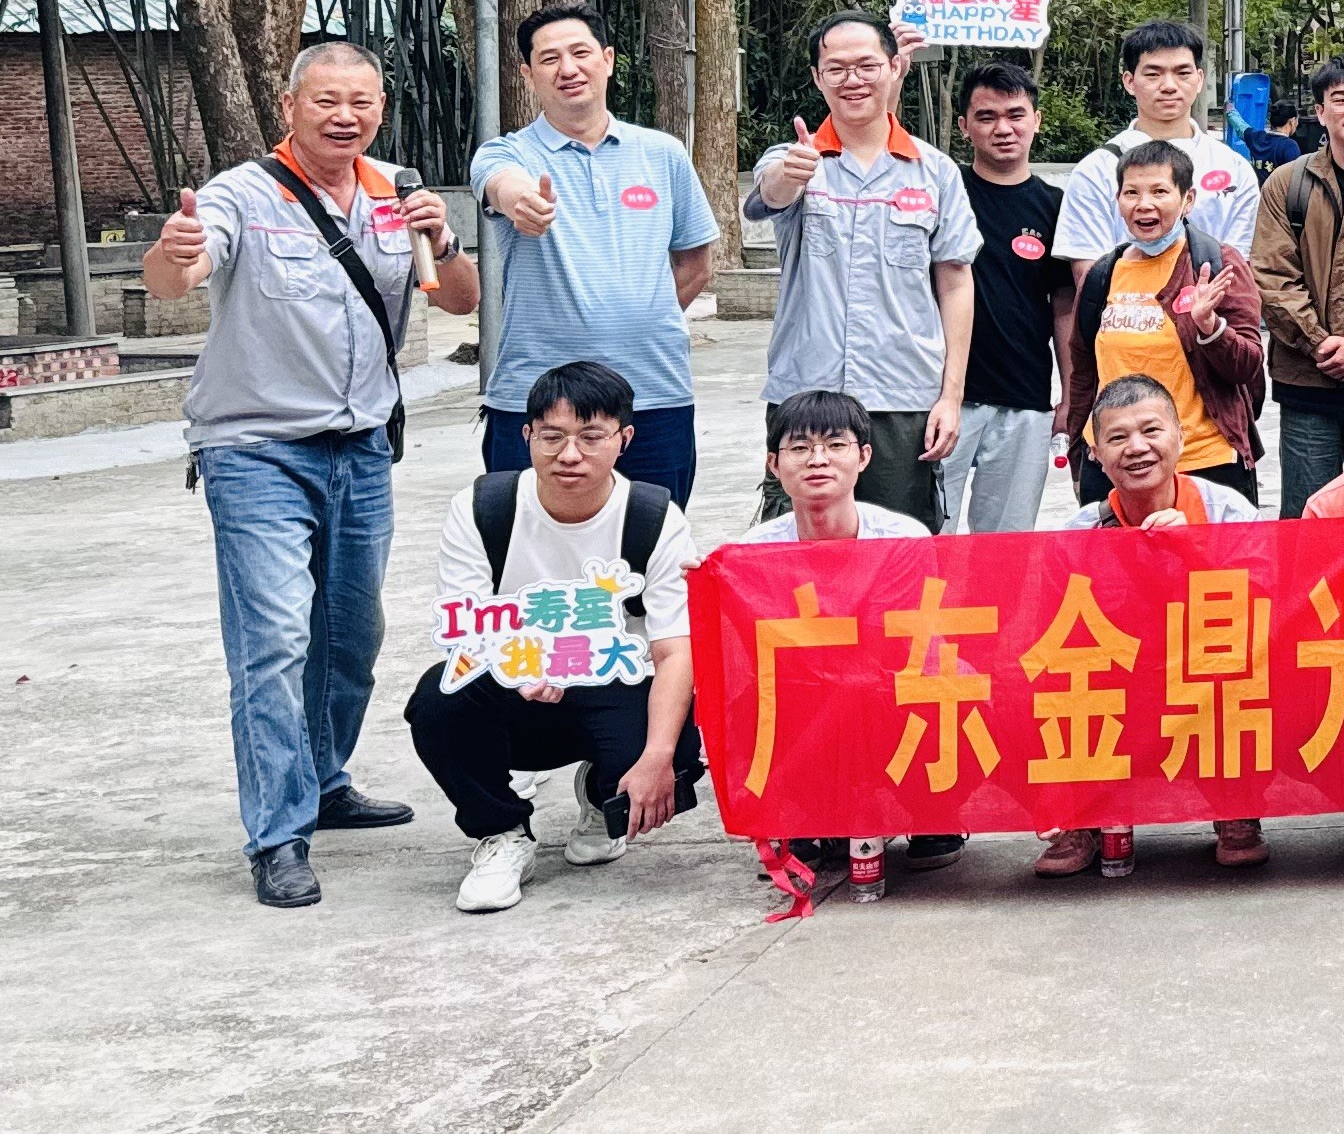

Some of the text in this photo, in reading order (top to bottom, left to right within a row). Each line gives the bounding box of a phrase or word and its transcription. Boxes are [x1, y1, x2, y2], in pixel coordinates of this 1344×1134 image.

[931, 4, 1013, 22] HAPPY
[499, 635, 638, 678] 我最大
